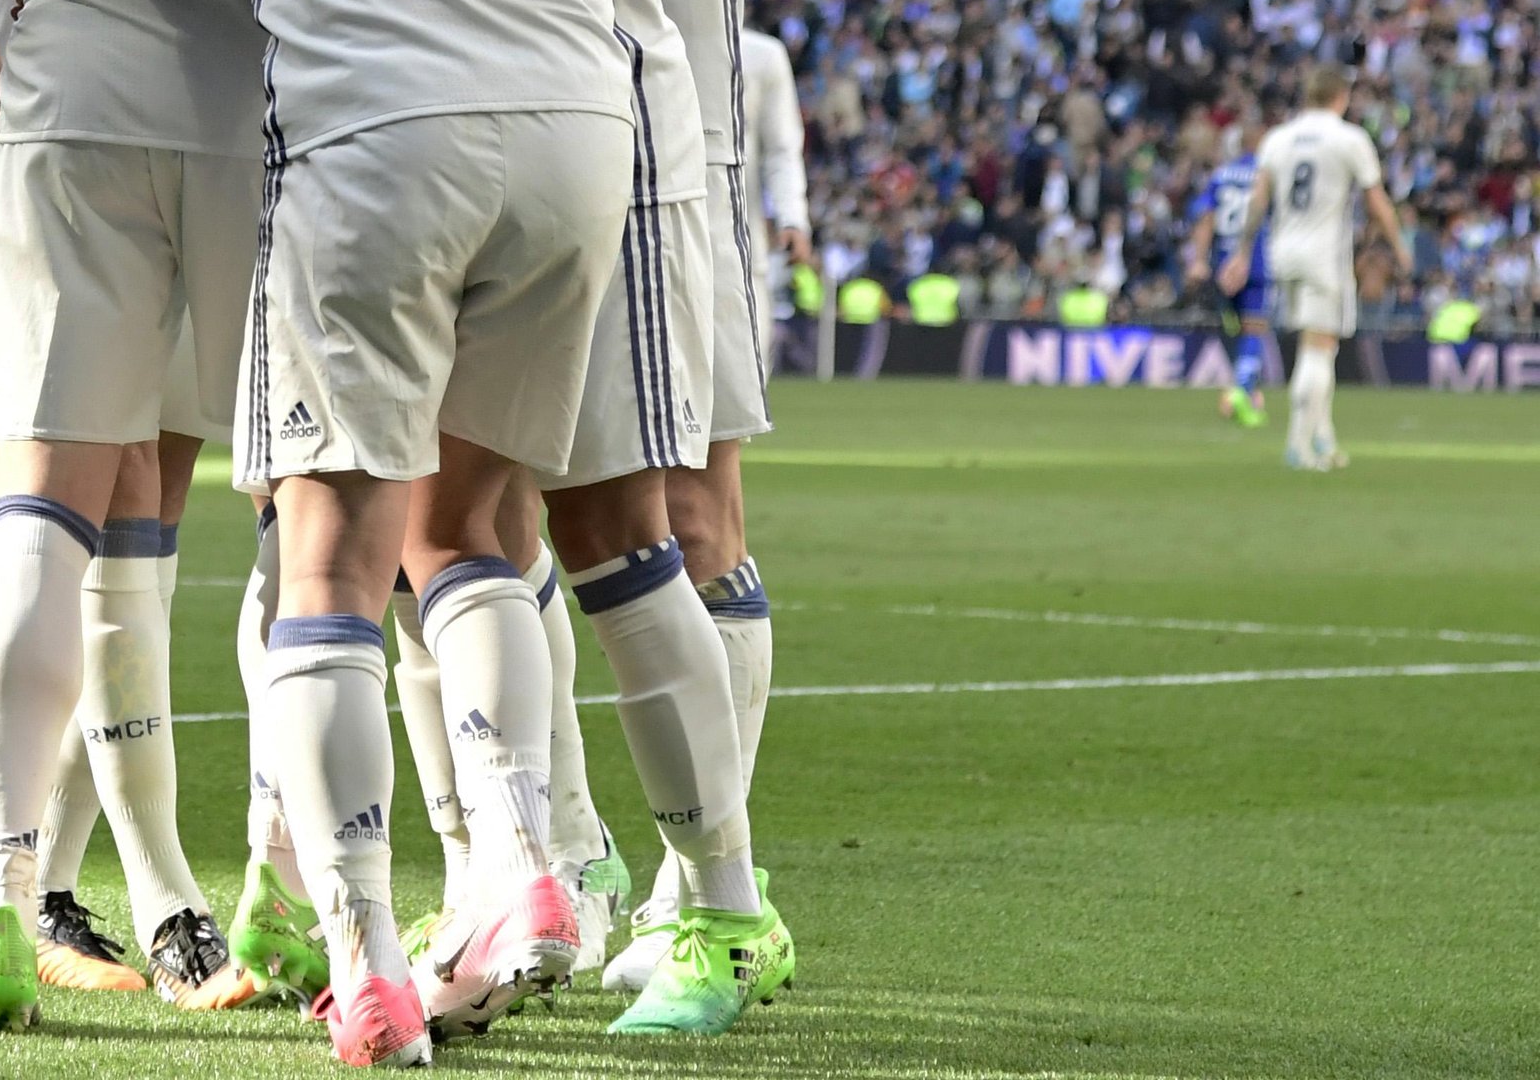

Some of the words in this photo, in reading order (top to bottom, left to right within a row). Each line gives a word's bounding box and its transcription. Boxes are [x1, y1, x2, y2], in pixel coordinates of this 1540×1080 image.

[1008, 325, 1239, 388] NIVEA
[279, 424, 322, 440] adidas
[86, 716, 162, 744] RMCF
